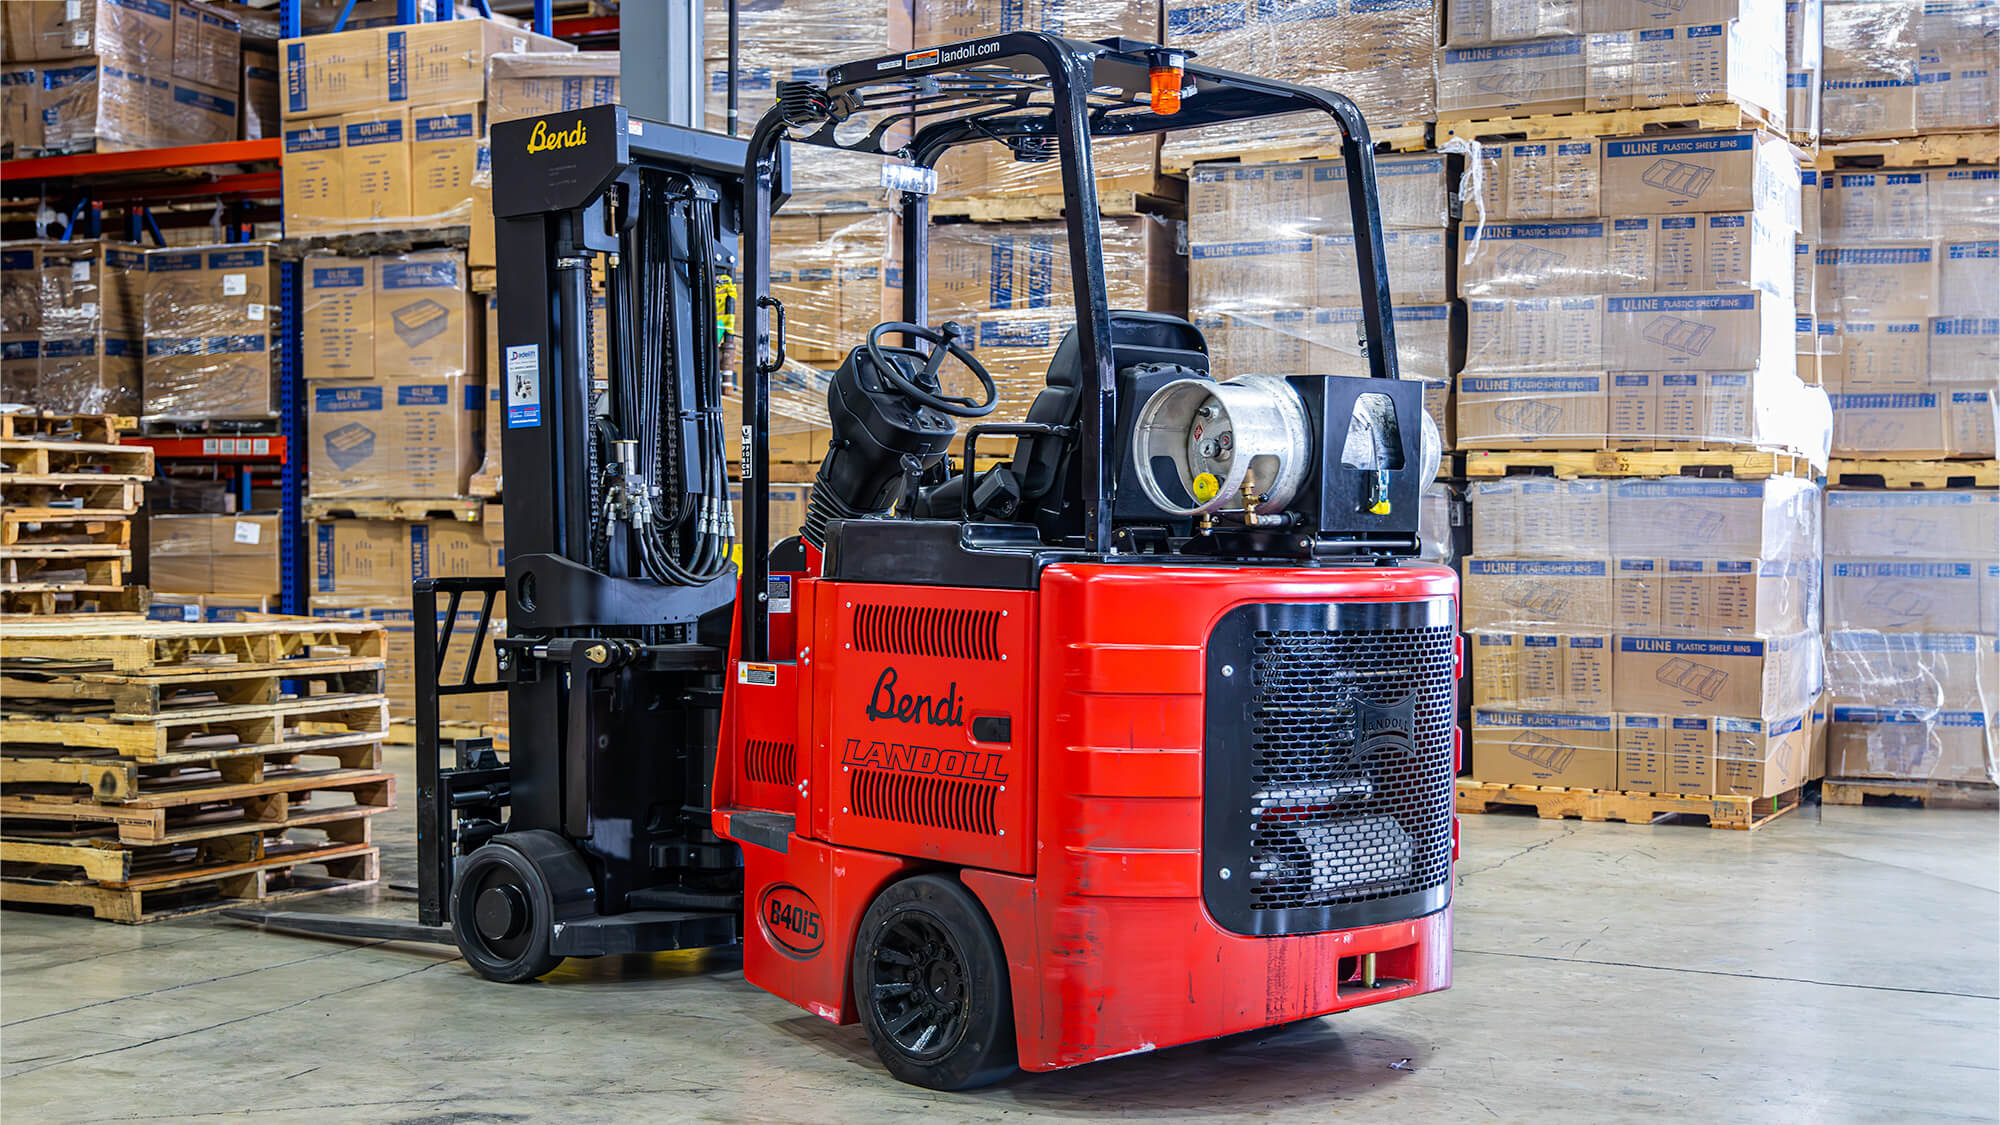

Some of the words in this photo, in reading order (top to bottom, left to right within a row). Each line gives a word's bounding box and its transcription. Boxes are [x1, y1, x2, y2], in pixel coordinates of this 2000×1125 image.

[941, 42, 1000, 63] landoll.com
[1459, 49, 1492, 61] ULINE
[289, 61, 299, 95] ULINE
[389, 51, 400, 84] ULINE
[527, 120, 588, 154] Bendi
[1622, 143, 1658, 154] ULINE
[1663, 143, 1693, 151] PLASTIC
[1695, 141, 1718, 149] SHELF
[1720, 140, 1737, 148] BINS
[1516, 227, 1546, 236] PLASTIC
[1548, 227, 1569, 235] SHELF
[1000, 250, 1010, 289] ULINE
[1622, 299, 1658, 311] ULINE
[1663, 300, 1693, 308] PLASTIC
[1475, 380, 1509, 391] ULINE
[413, 541, 422, 576] ULINE
[1482, 563, 1516, 573] ULINE
[1635, 639, 1672, 651] ULINE
[1676, 643, 1706, 652] PLASTIC
[1709, 644, 1731, 652] SHELF
[1733, 645, 1751, 653] BINS
[865, 666, 964, 727] Bendi
[1489, 712, 1523, 724] ULINE
[1527, 716, 1555, 725] PLASTIC
[841, 739, 1009, 782] LANDOLL
[770, 898, 820, 940] B40i5
